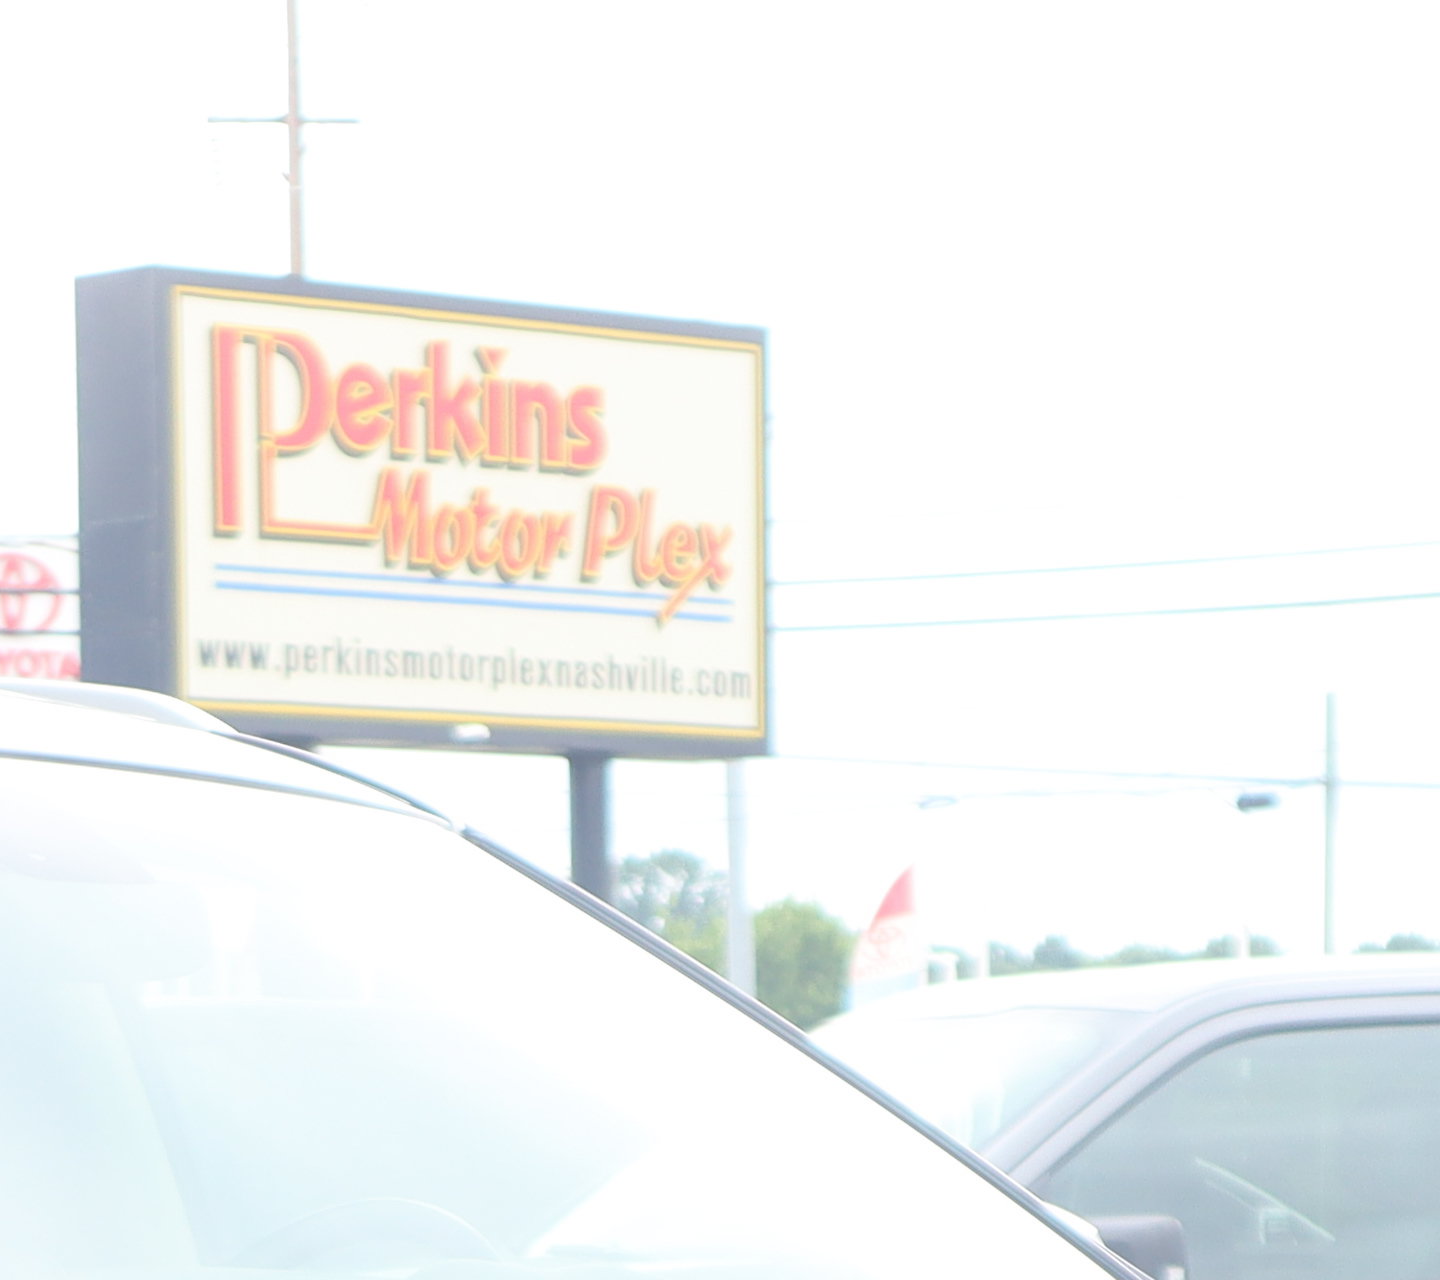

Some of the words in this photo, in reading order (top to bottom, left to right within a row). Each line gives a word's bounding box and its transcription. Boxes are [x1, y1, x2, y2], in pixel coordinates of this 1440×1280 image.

[210, 322, 609, 538] Perkins
[373, 467, 575, 583] Motor
[582, 485, 734, 628] Plex
[196, 636, 753, 701] www.perkinsmotorplexnashville.com
